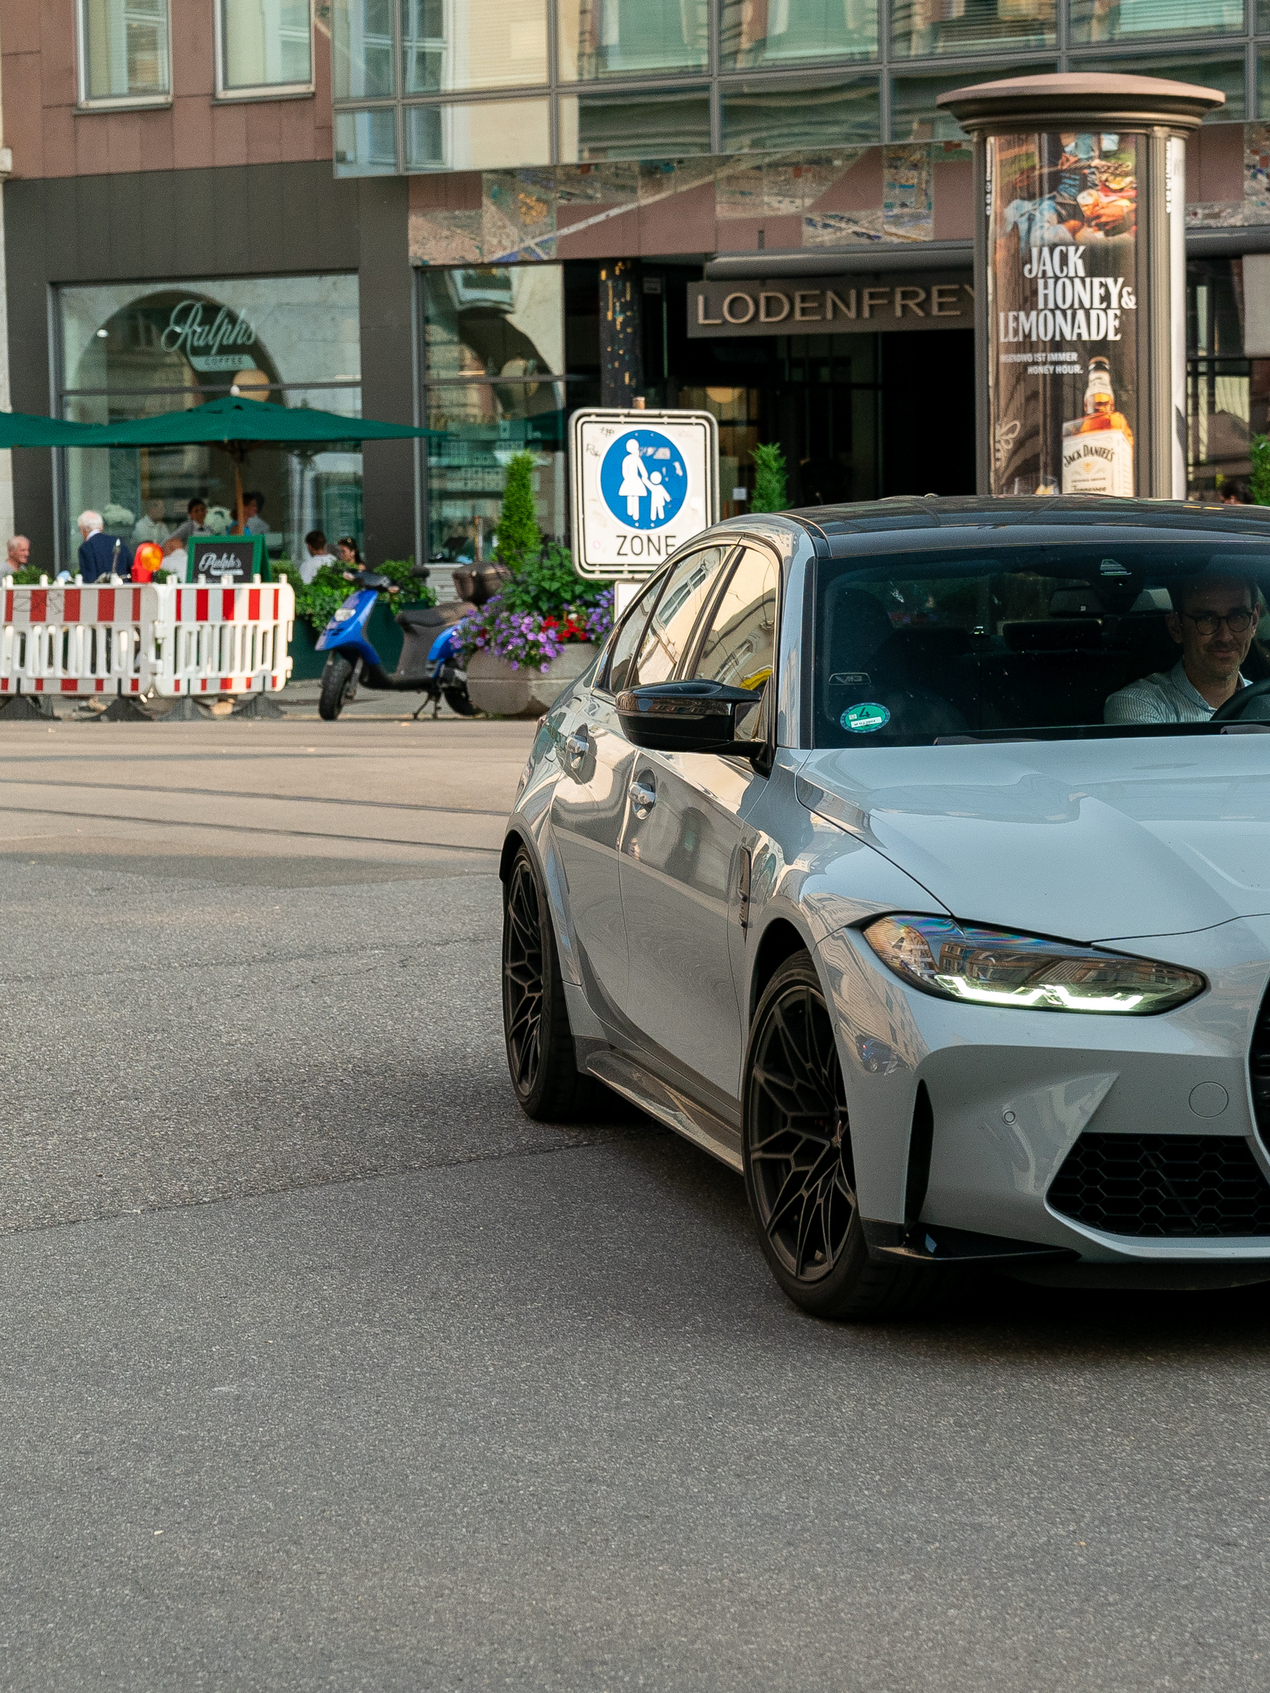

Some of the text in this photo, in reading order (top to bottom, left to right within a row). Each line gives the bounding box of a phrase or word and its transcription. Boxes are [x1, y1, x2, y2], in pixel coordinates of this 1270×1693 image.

[1023, 245, 1086, 278] JACK
[999, 308, 1122, 343] LEMONADE
[1047, 351, 1078, 362] IMMER
[1027, 364, 1055, 375] HONEY
[1063, 449, 1082, 468] JACK
[615, 534, 677, 557] ZONE
[859, 707, 871, 718] 4
